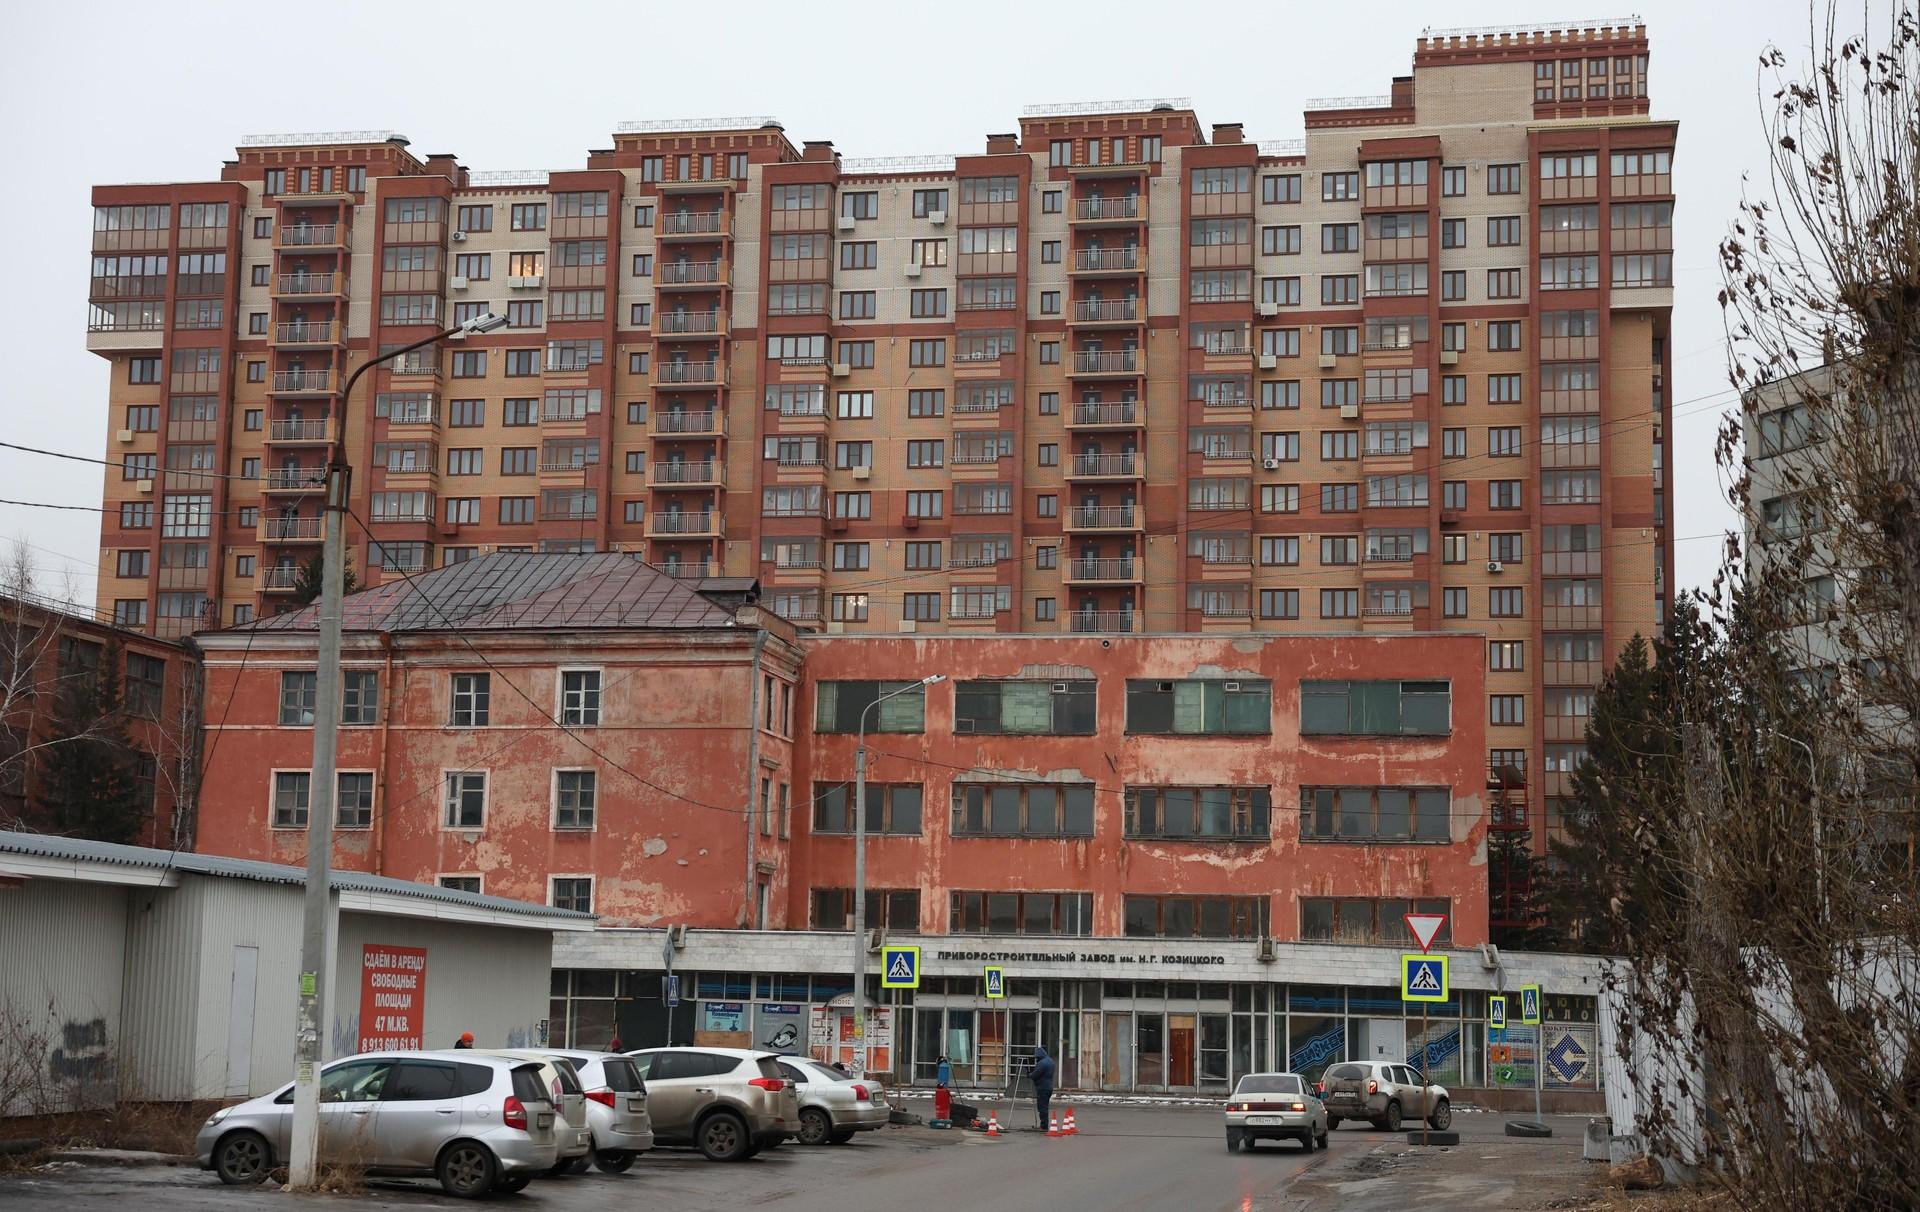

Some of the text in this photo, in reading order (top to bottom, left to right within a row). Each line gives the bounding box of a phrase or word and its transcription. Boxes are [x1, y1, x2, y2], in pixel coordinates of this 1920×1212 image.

[364, 950, 425, 972] СДАЁМ В АРЕНДУ
[937, 951, 1076, 962] ПРИБОРОСТРОИТЕЛЬНЫЙ
[1080, 954, 1116, 963] ЗАВОД
[1162, 955, 1225, 965] КОЗИЦКОГО
[371, 973, 417, 990] СВОБОДНЫЕ
[375, 993, 412, 1010] ПЛОЩАДИ
[1547, 1009, 1589, 1020] АЛО
[375, 1016, 409, 1031] 47 М.КВ.
[362, 1038, 367, 1052] 8
